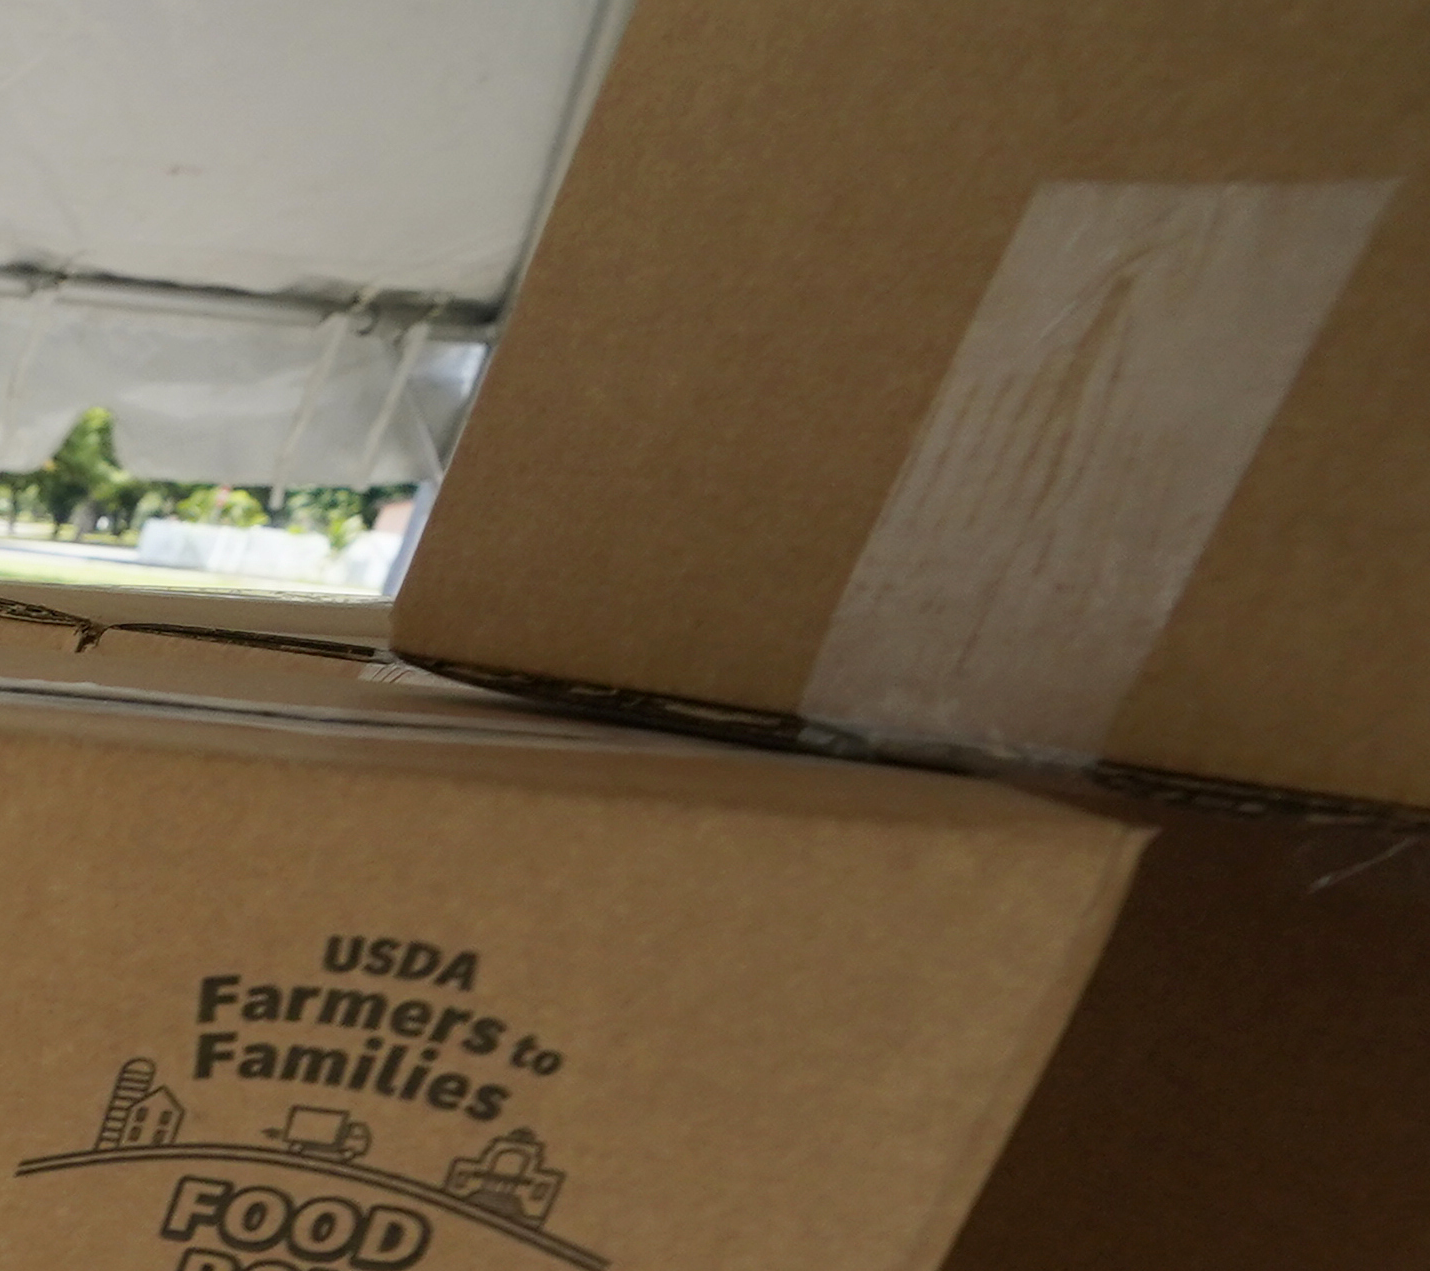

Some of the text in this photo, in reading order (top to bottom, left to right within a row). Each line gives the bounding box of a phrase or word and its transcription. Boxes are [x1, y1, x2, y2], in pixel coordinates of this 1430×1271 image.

[323, 934, 479, 992] USDA
[196, 974, 564, 1077] Farmers to
[193, 1031, 511, 1122] Families
[161, 1175, 431, 1271] FOOD
